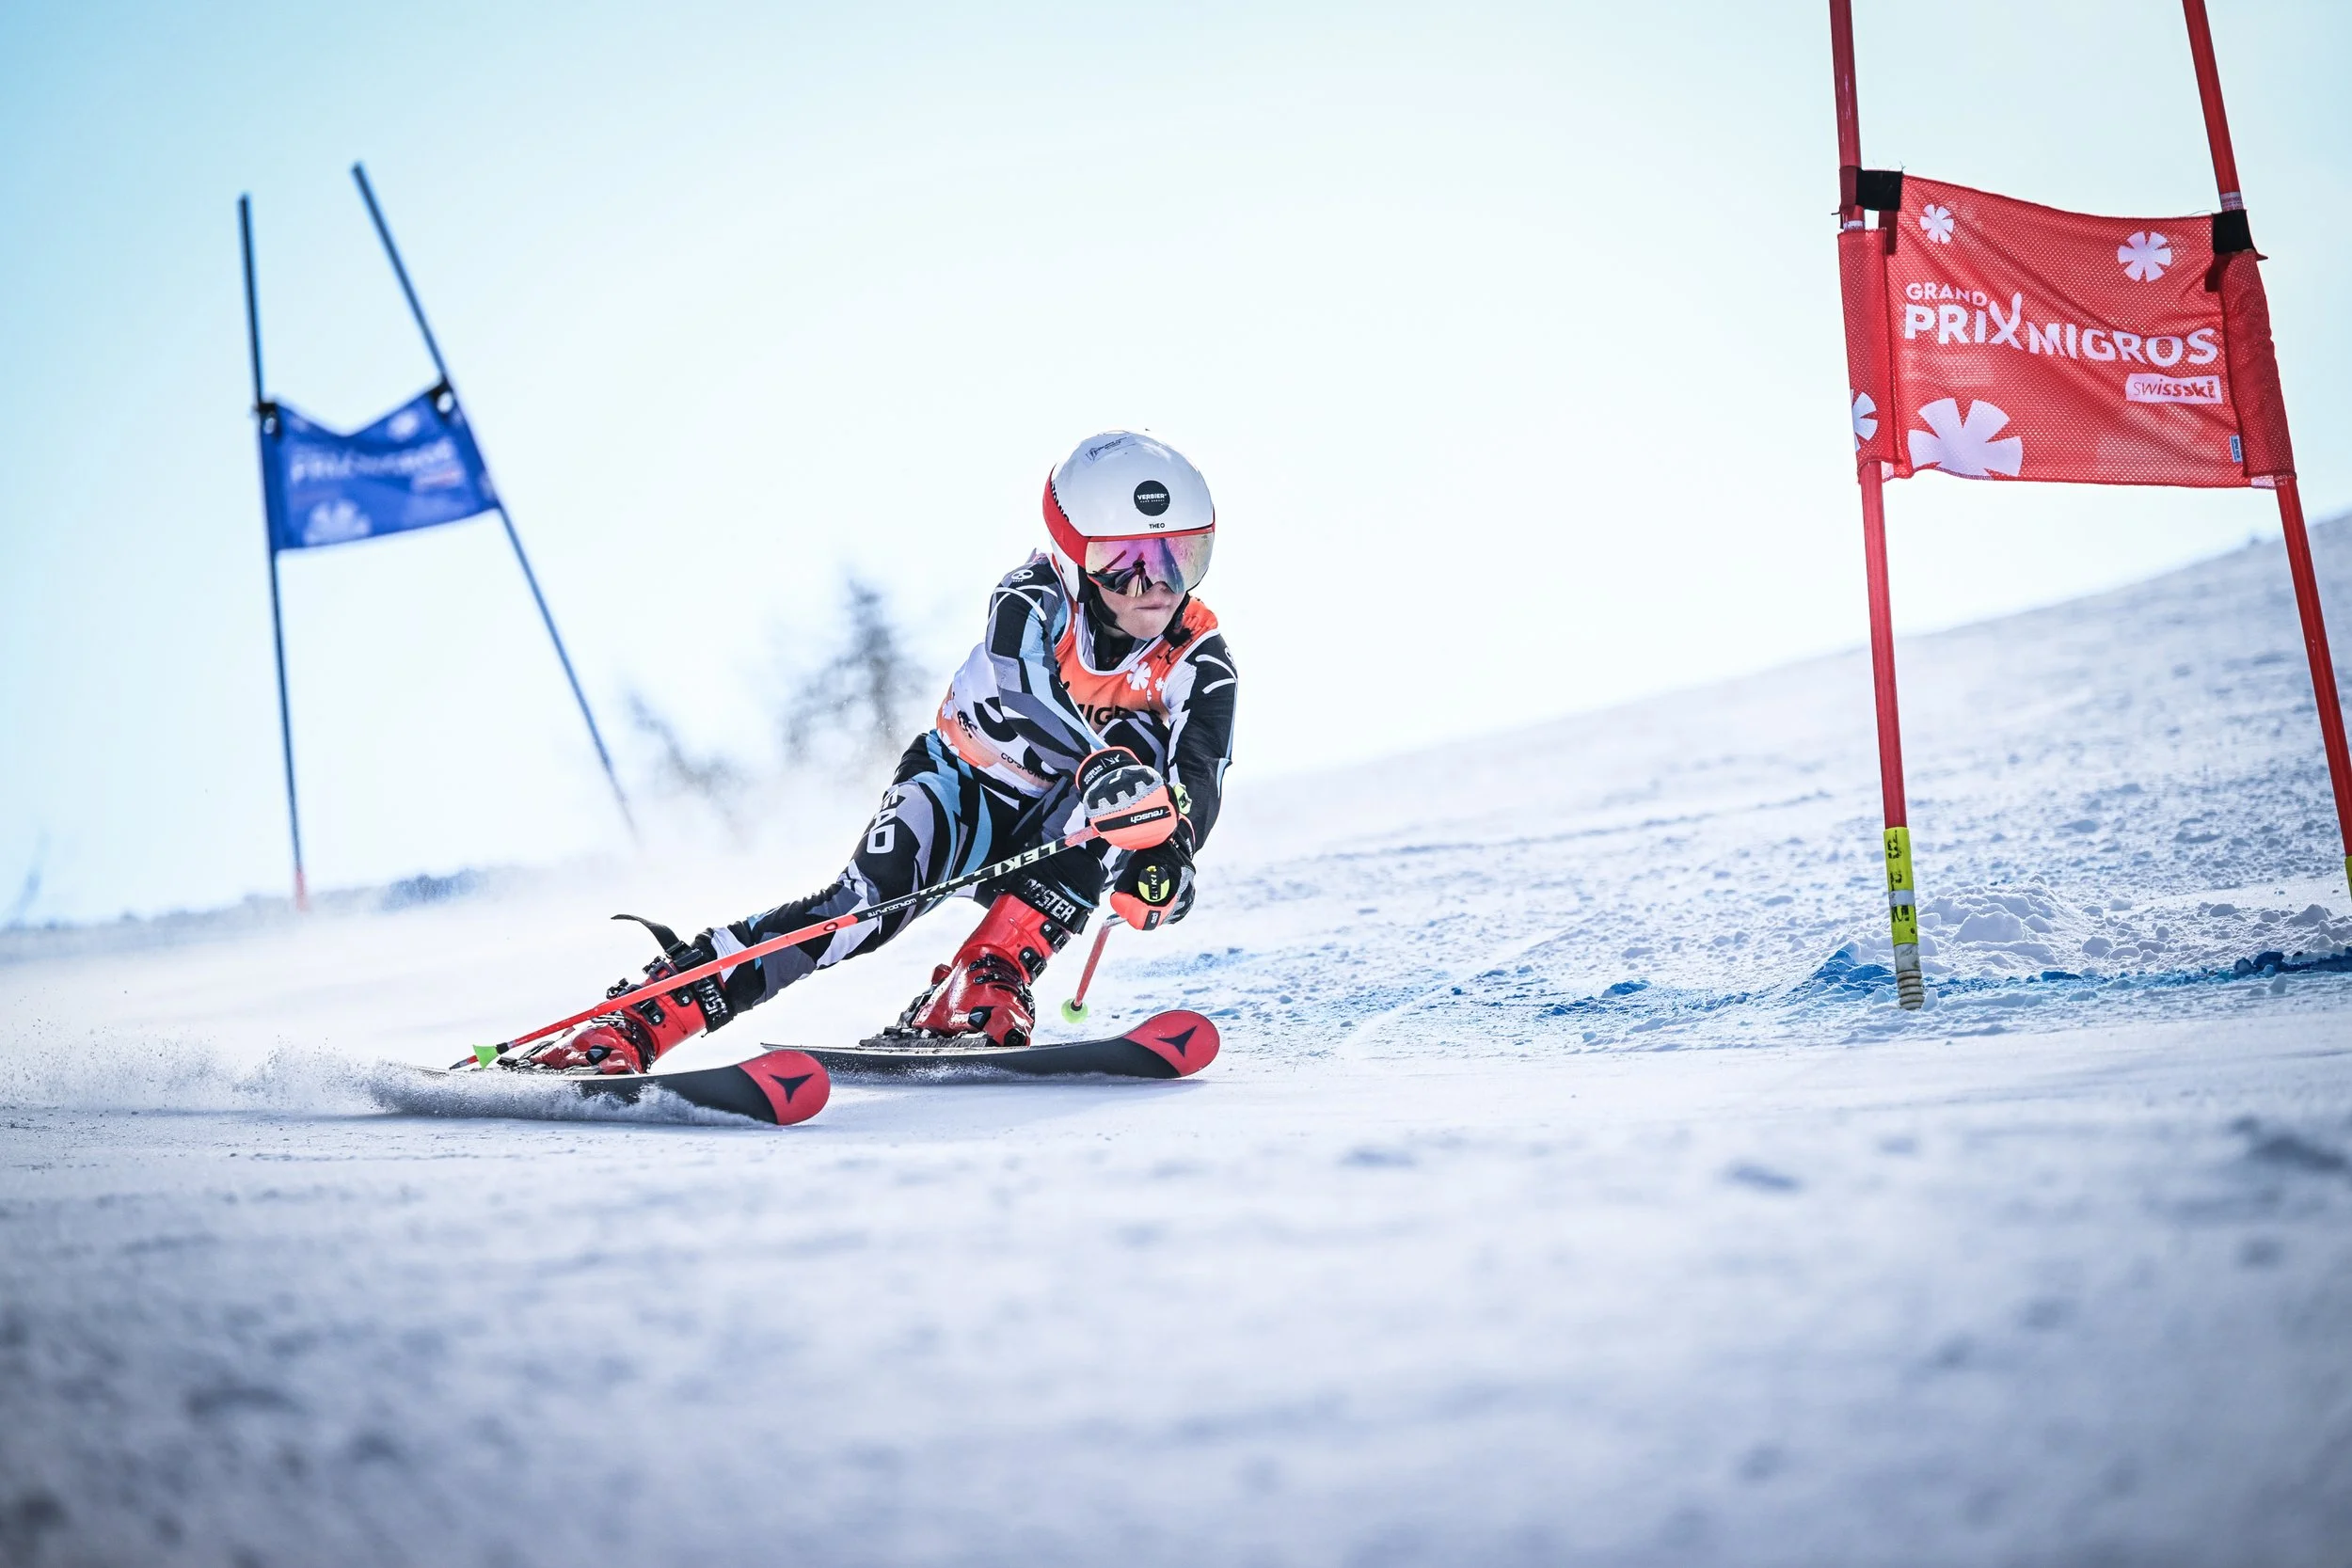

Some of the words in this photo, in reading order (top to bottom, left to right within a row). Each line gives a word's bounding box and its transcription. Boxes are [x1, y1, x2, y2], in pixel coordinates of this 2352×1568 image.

[1906, 282, 1987, 306] GRAND
[1904, 292, 2024, 351] PRIX
[2026, 322, 2218, 366] MIGROS
[866, 786, 899, 854] EAD
[1129, 808, 1164, 824] reusch
[993, 839, 1057, 878] LEKI
